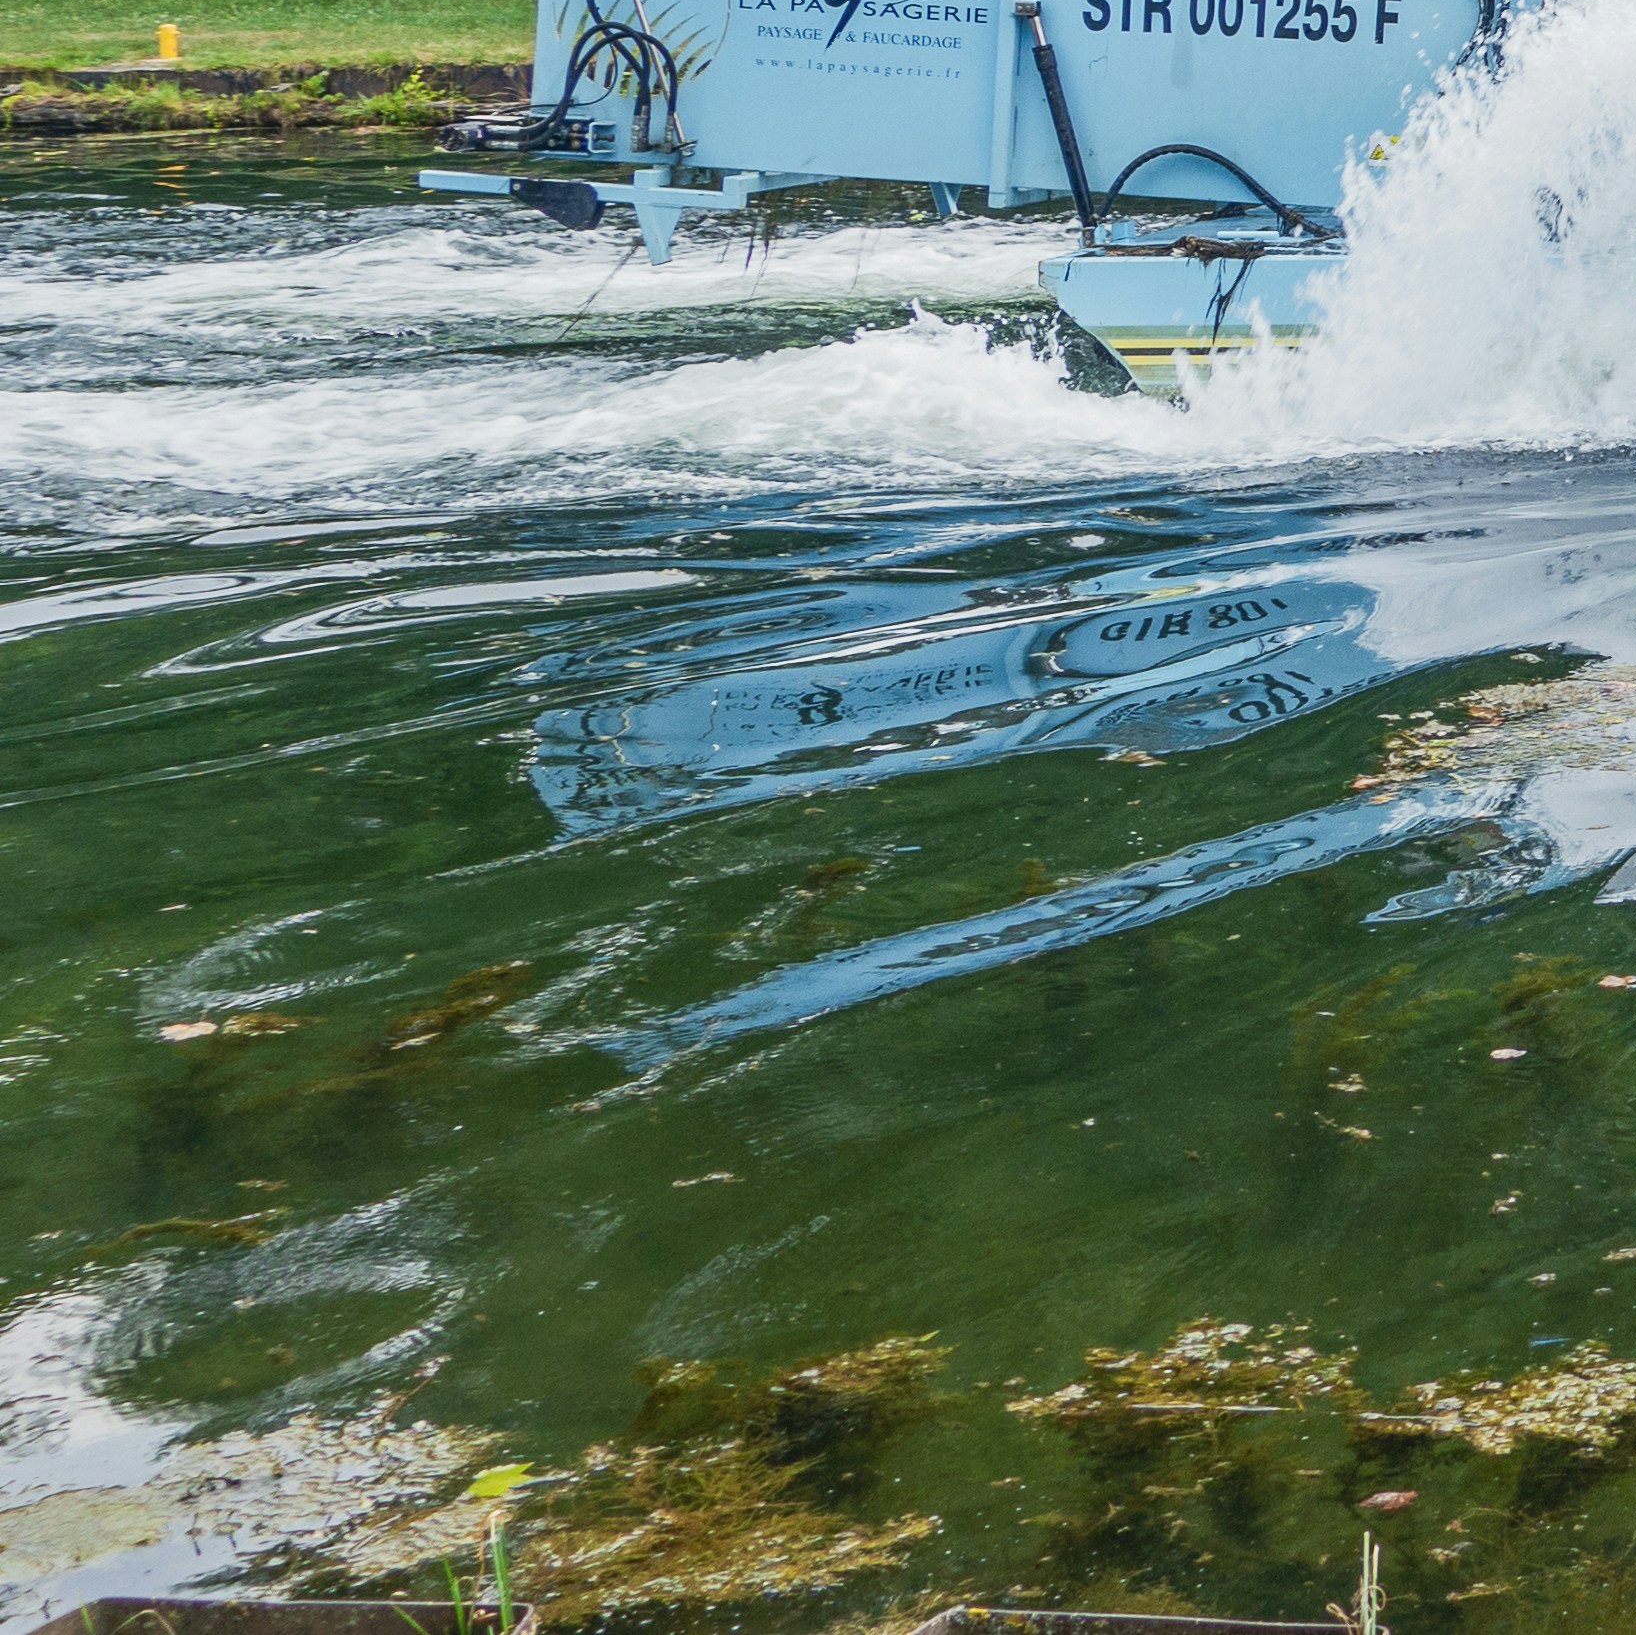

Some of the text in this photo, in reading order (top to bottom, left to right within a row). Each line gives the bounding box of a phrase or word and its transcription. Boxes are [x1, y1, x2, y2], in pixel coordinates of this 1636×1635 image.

[757, 25, 963, 49] PAYSAGE & FAUCARDAGE
[755, 57, 961, 79] www.lapaysagerie.fr
